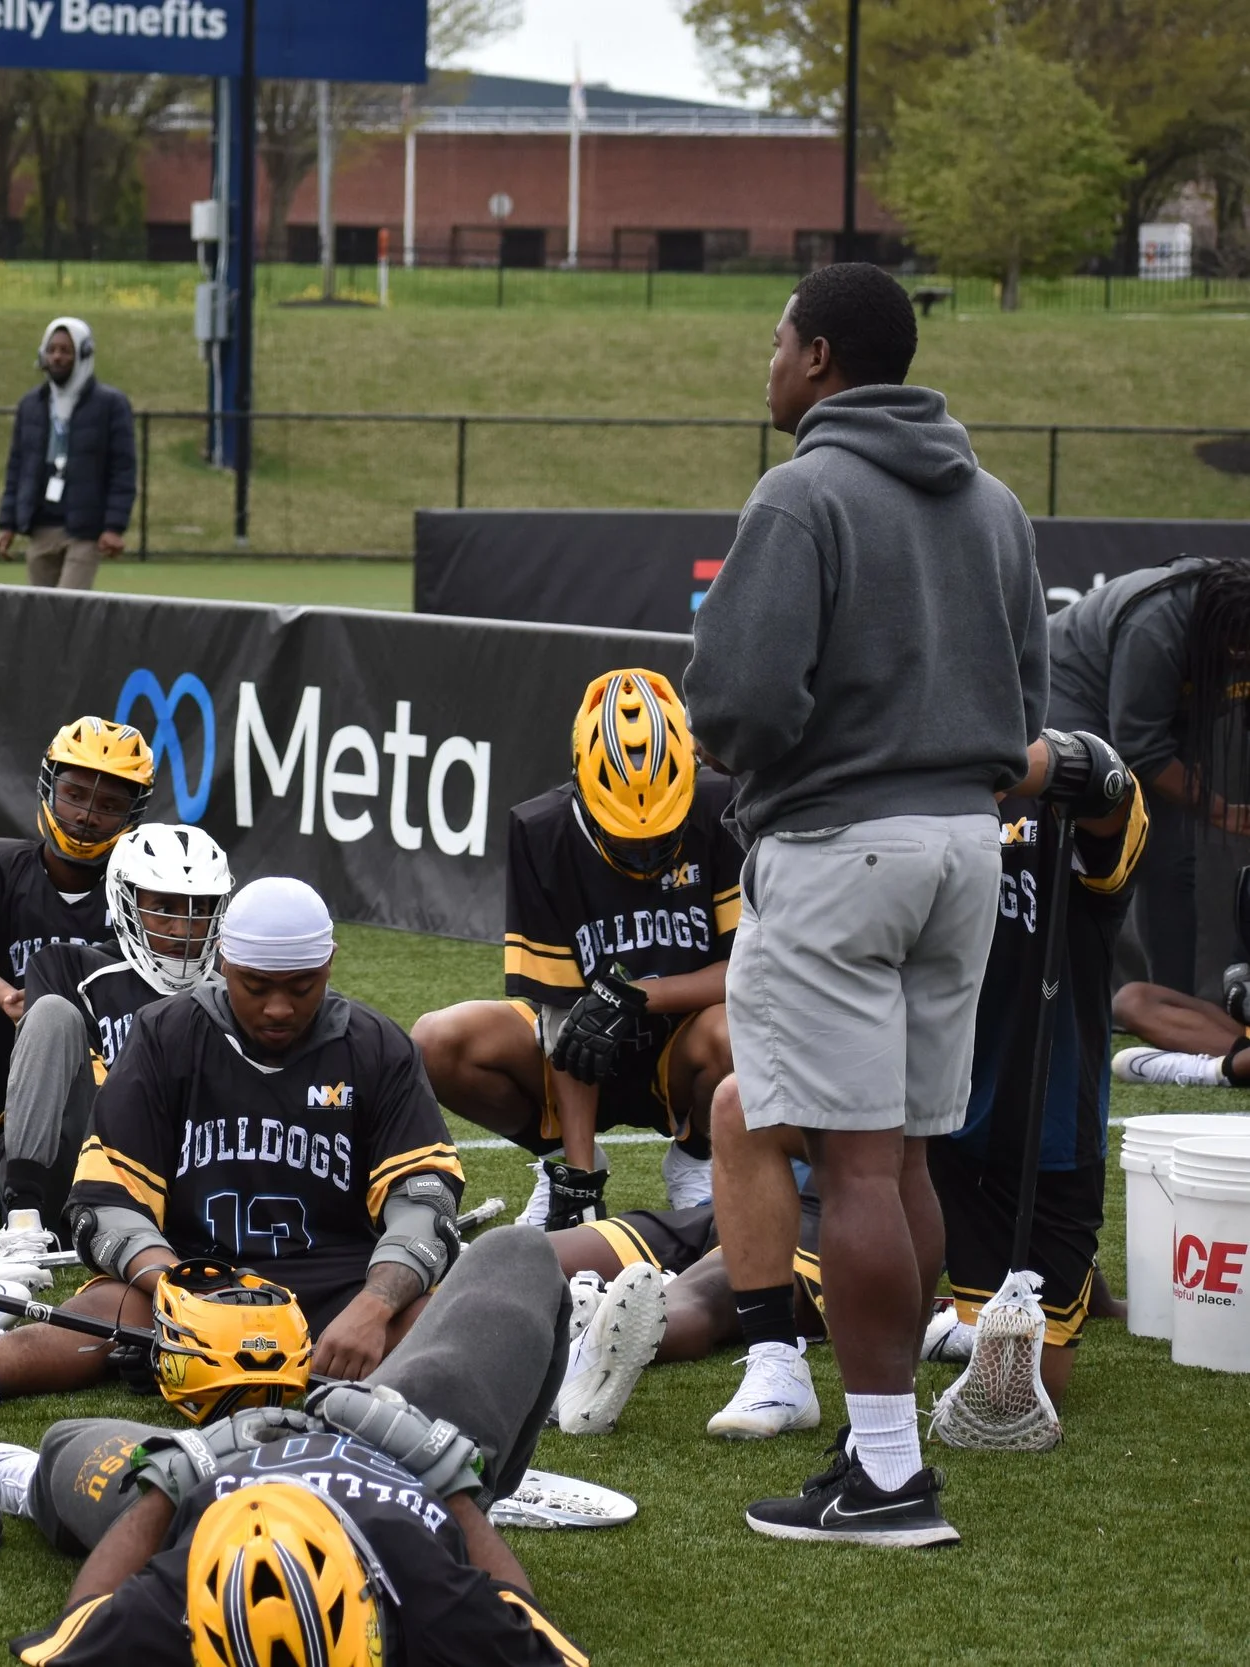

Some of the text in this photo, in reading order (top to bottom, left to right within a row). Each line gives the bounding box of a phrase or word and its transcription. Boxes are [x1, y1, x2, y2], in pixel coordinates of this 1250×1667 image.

[60, 0, 227, 39] Benefits
[234, 681, 491, 857] Meta
[307, 1081, 353, 1106] NXT
[1173, 1220, 1248, 1294] CE
[1197, 1293, 1236, 1306] place.
